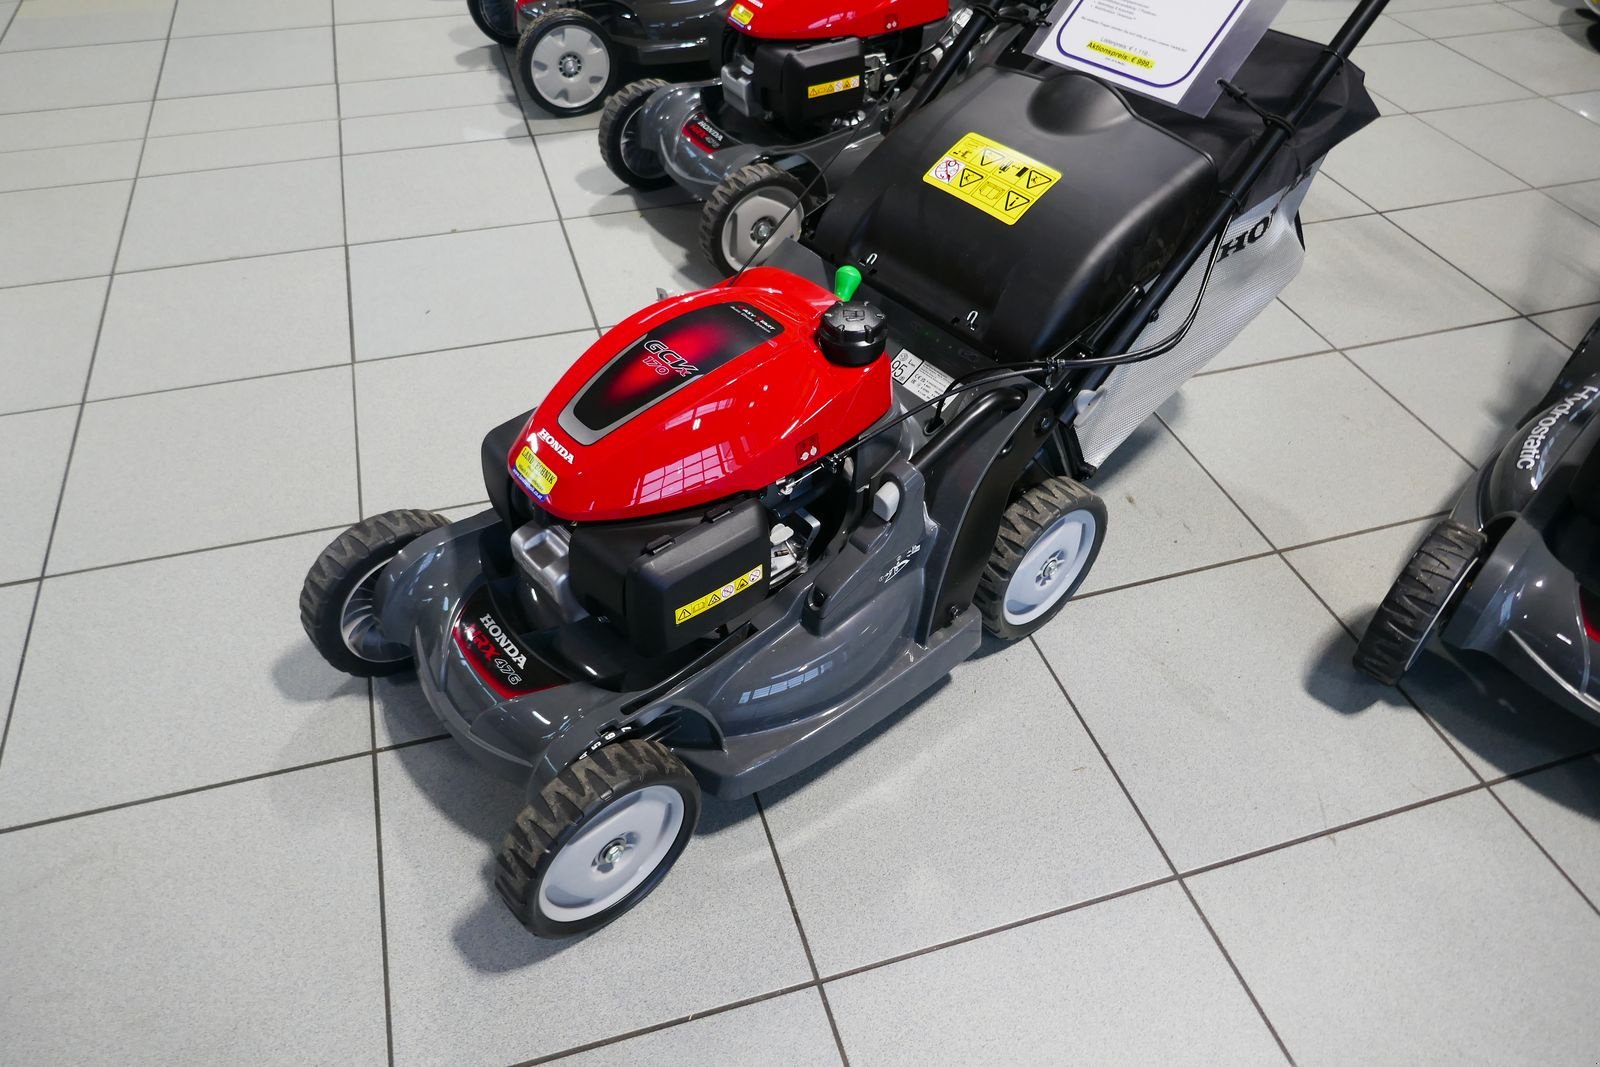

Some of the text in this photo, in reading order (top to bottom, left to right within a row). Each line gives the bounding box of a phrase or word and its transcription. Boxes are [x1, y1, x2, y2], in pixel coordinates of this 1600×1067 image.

[1086, 41, 1130, 61] Aktionspreis:
[697, 121, 723, 141] HONDA
[642, 356, 670, 375] 170
[891, 360, 908, 378] 95
[1516, 385, 1599, 471] Hydrostatic
[536, 427, 575, 465] HONDA
[479, 612, 527, 670] HONDA
[494, 658, 523, 686] 476
[590, 741, 602, 751] 5
[604, 732, 616, 741] 6
